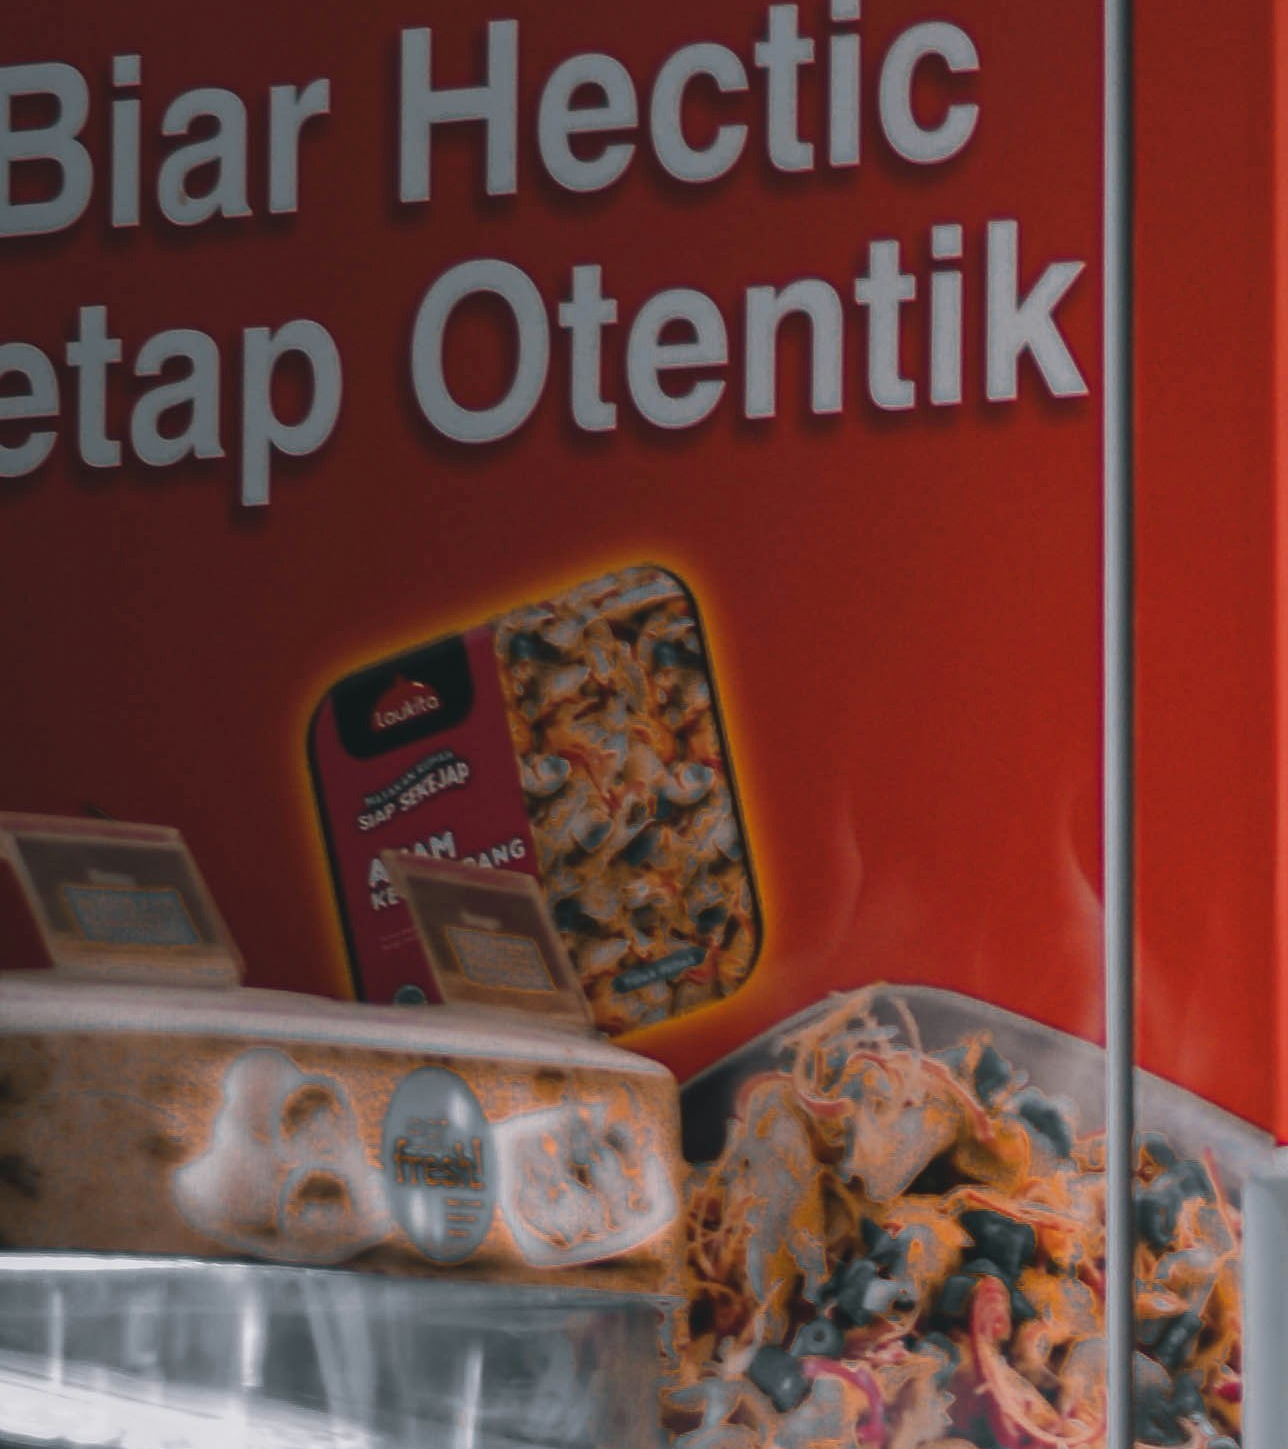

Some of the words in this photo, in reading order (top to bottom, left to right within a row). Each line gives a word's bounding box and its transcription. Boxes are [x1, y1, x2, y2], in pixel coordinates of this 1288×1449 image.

[0, 54, 331, 238] Biar
[0, 305, 344, 508] etap
[411, 218, 1090, 444] Otentik
[356, 800, 397, 832] SIAP
[399, 760, 471, 814] SEKEJAP
[367, 831, 457, 889] AAM
